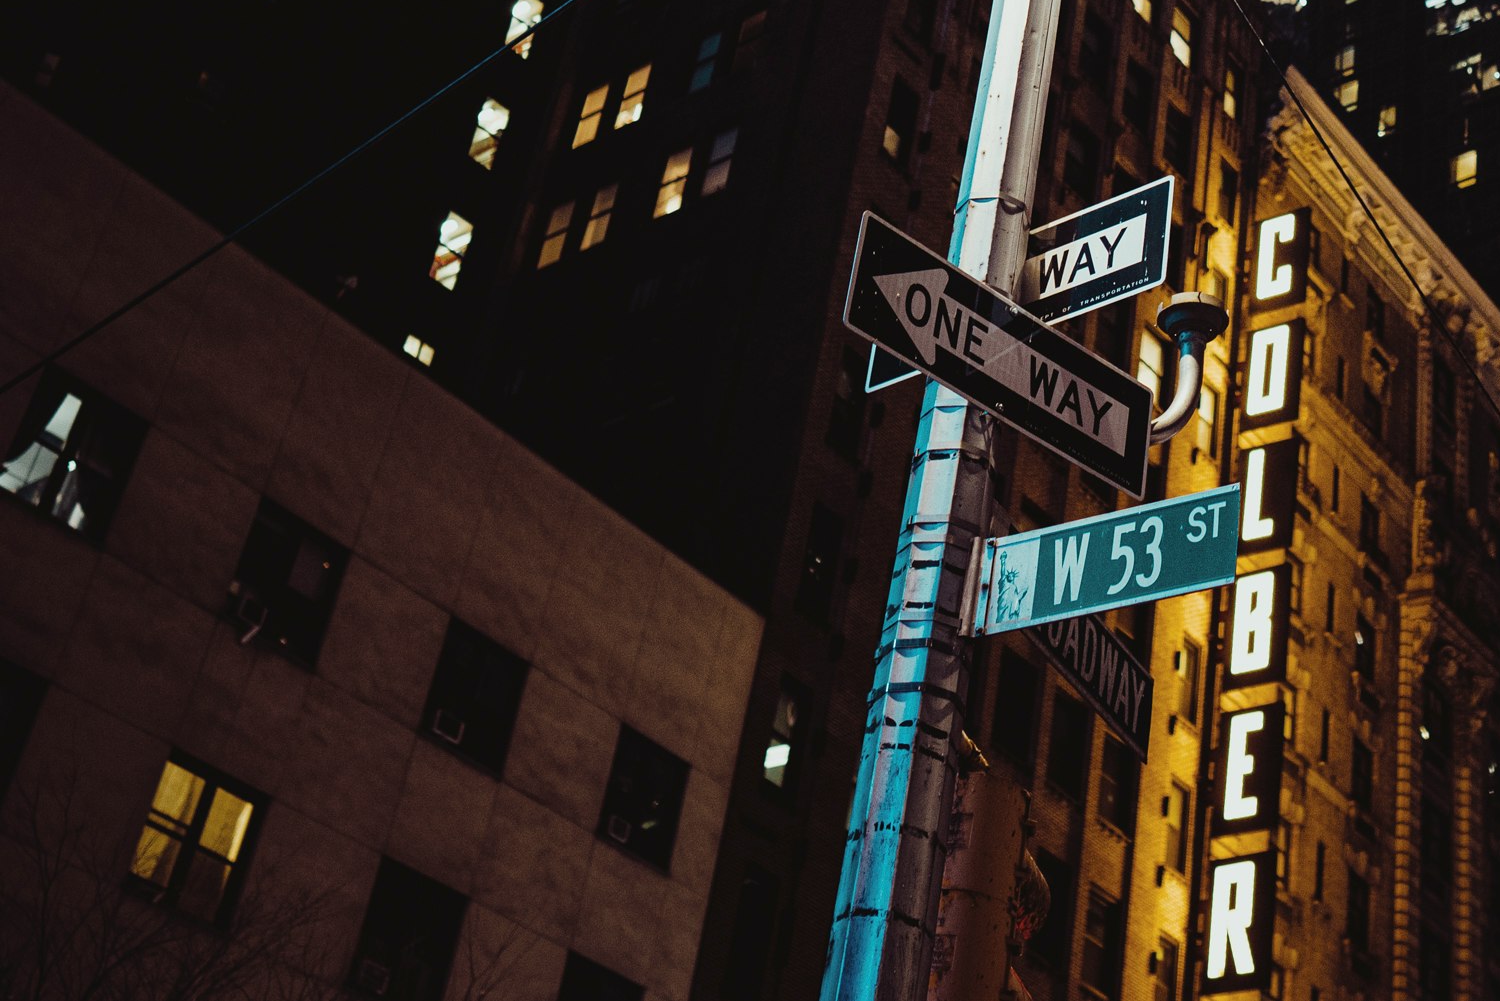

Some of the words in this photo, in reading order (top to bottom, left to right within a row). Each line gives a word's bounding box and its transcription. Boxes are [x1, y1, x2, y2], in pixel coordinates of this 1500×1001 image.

[1040, 227, 1128, 294] WAY
[1062, 305, 1072, 313] OF
[1080, 277, 1149, 307] TRANSPORTATION
[905, 283, 989, 367] ONE
[1029, 354, 1113, 437] WAY
[1053, 532, 1091, 606] W
[1107, 516, 1164, 595] 53
[1186, 501, 1227, 543] ST
